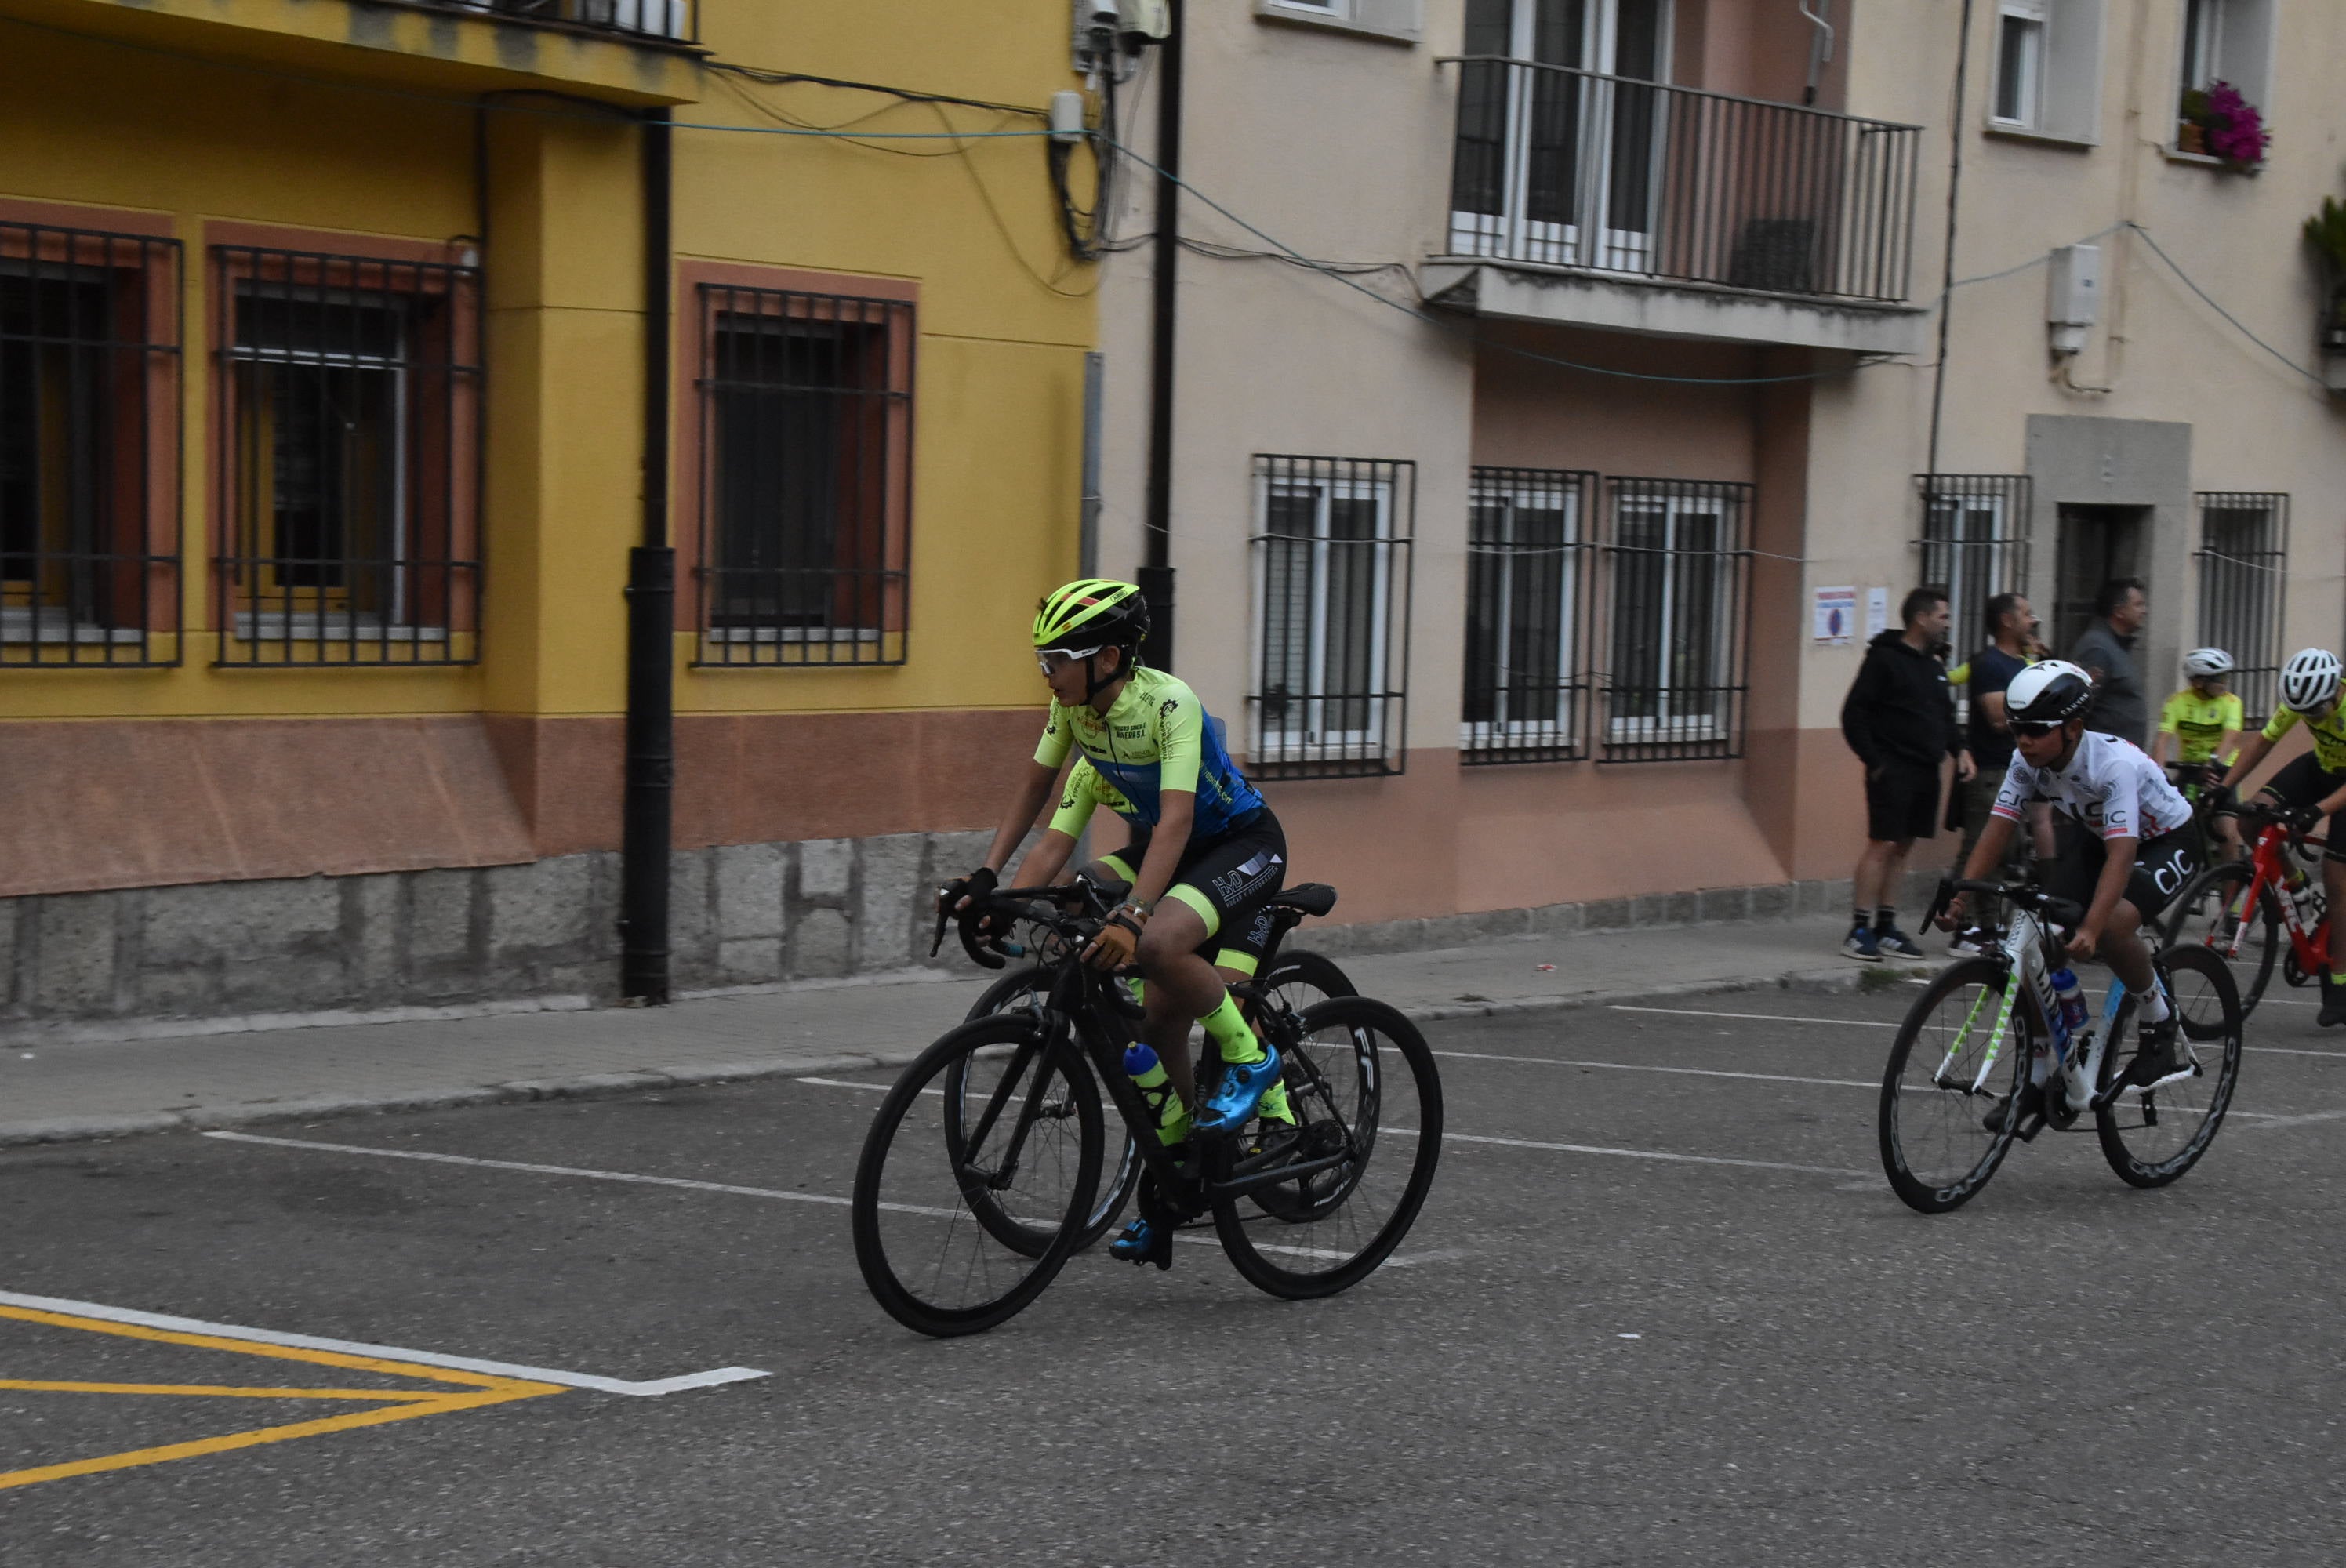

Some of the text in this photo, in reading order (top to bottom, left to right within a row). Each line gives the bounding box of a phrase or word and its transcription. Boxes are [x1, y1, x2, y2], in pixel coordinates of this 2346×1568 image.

[2060, 692, 2090, 715] CANYON
[2104, 810, 2126, 824] JC
[1211, 870, 1243, 896] HYD
[2155, 849, 2193, 895] CJC
